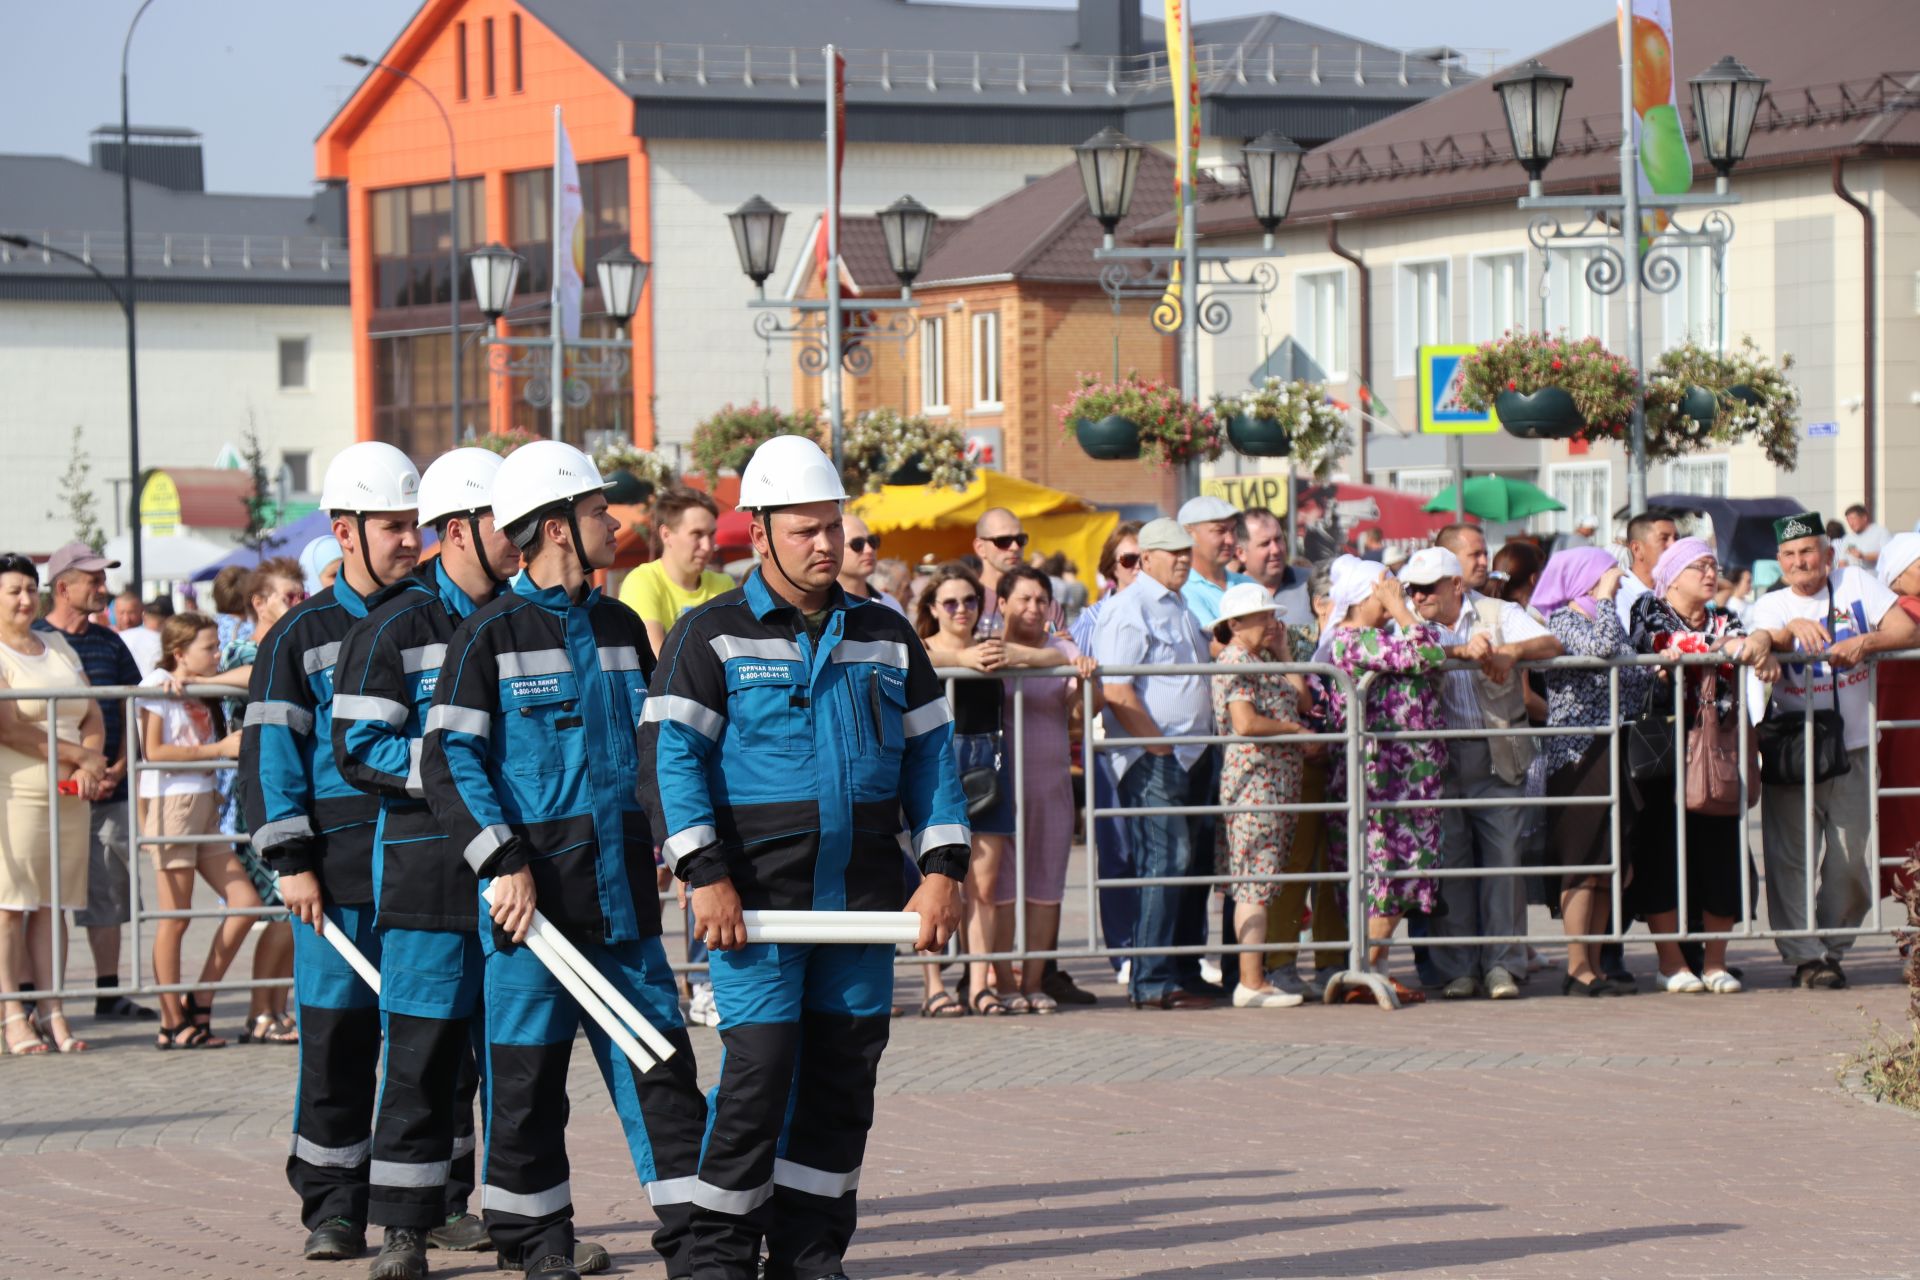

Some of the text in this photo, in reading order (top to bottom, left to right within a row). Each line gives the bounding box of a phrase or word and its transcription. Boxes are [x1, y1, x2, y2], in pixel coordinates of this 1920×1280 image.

[1223, 480, 1279, 509] ТИР
[740, 672, 790, 680] 8-800-100-41-12
[511, 680, 537, 688] ГОРЯЧАЯ
[513, 686, 559, 696] 8-800-100-41-12
